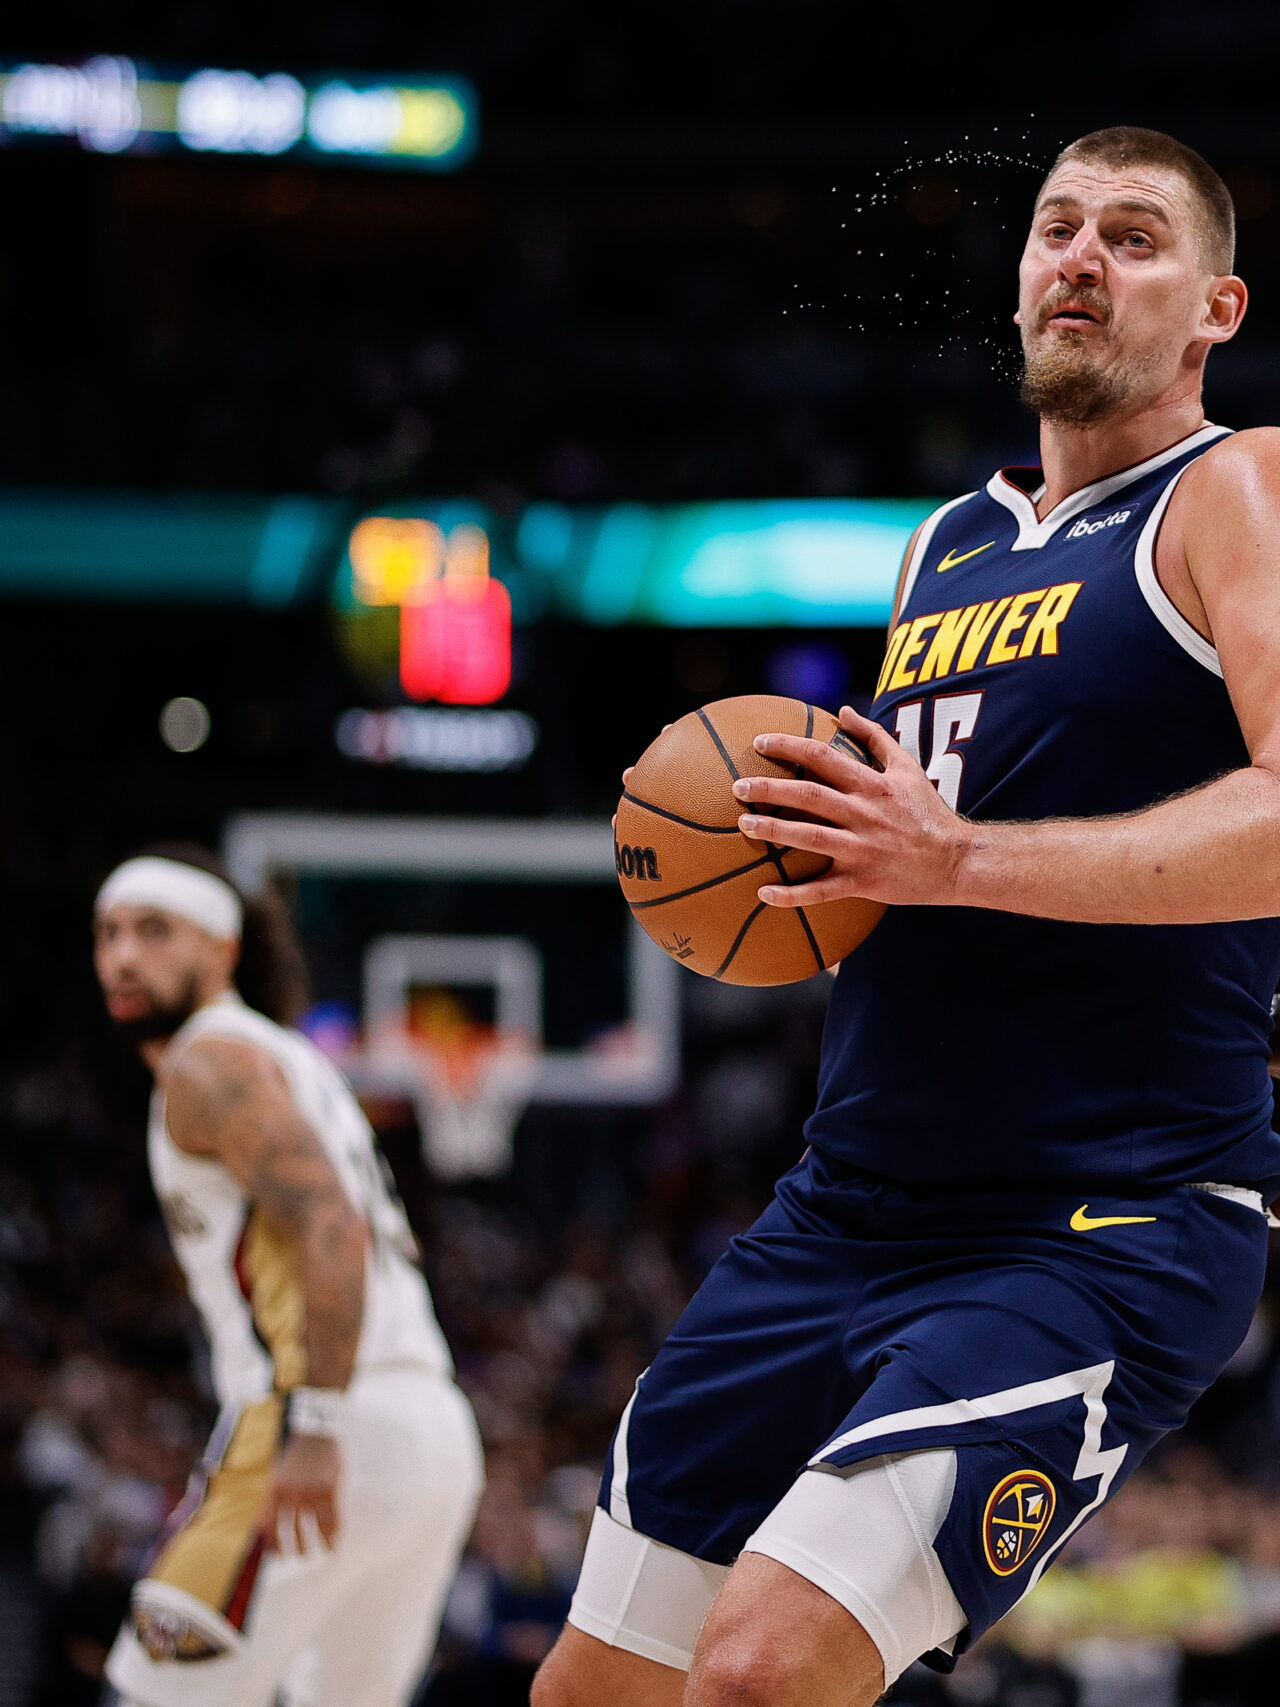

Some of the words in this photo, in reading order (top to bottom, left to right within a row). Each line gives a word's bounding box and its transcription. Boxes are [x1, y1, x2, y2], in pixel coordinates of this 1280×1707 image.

[1065, 510, 1132, 539] ibotta
[873, 581, 1087, 704] DENVER
[894, 689, 986, 815] 15
